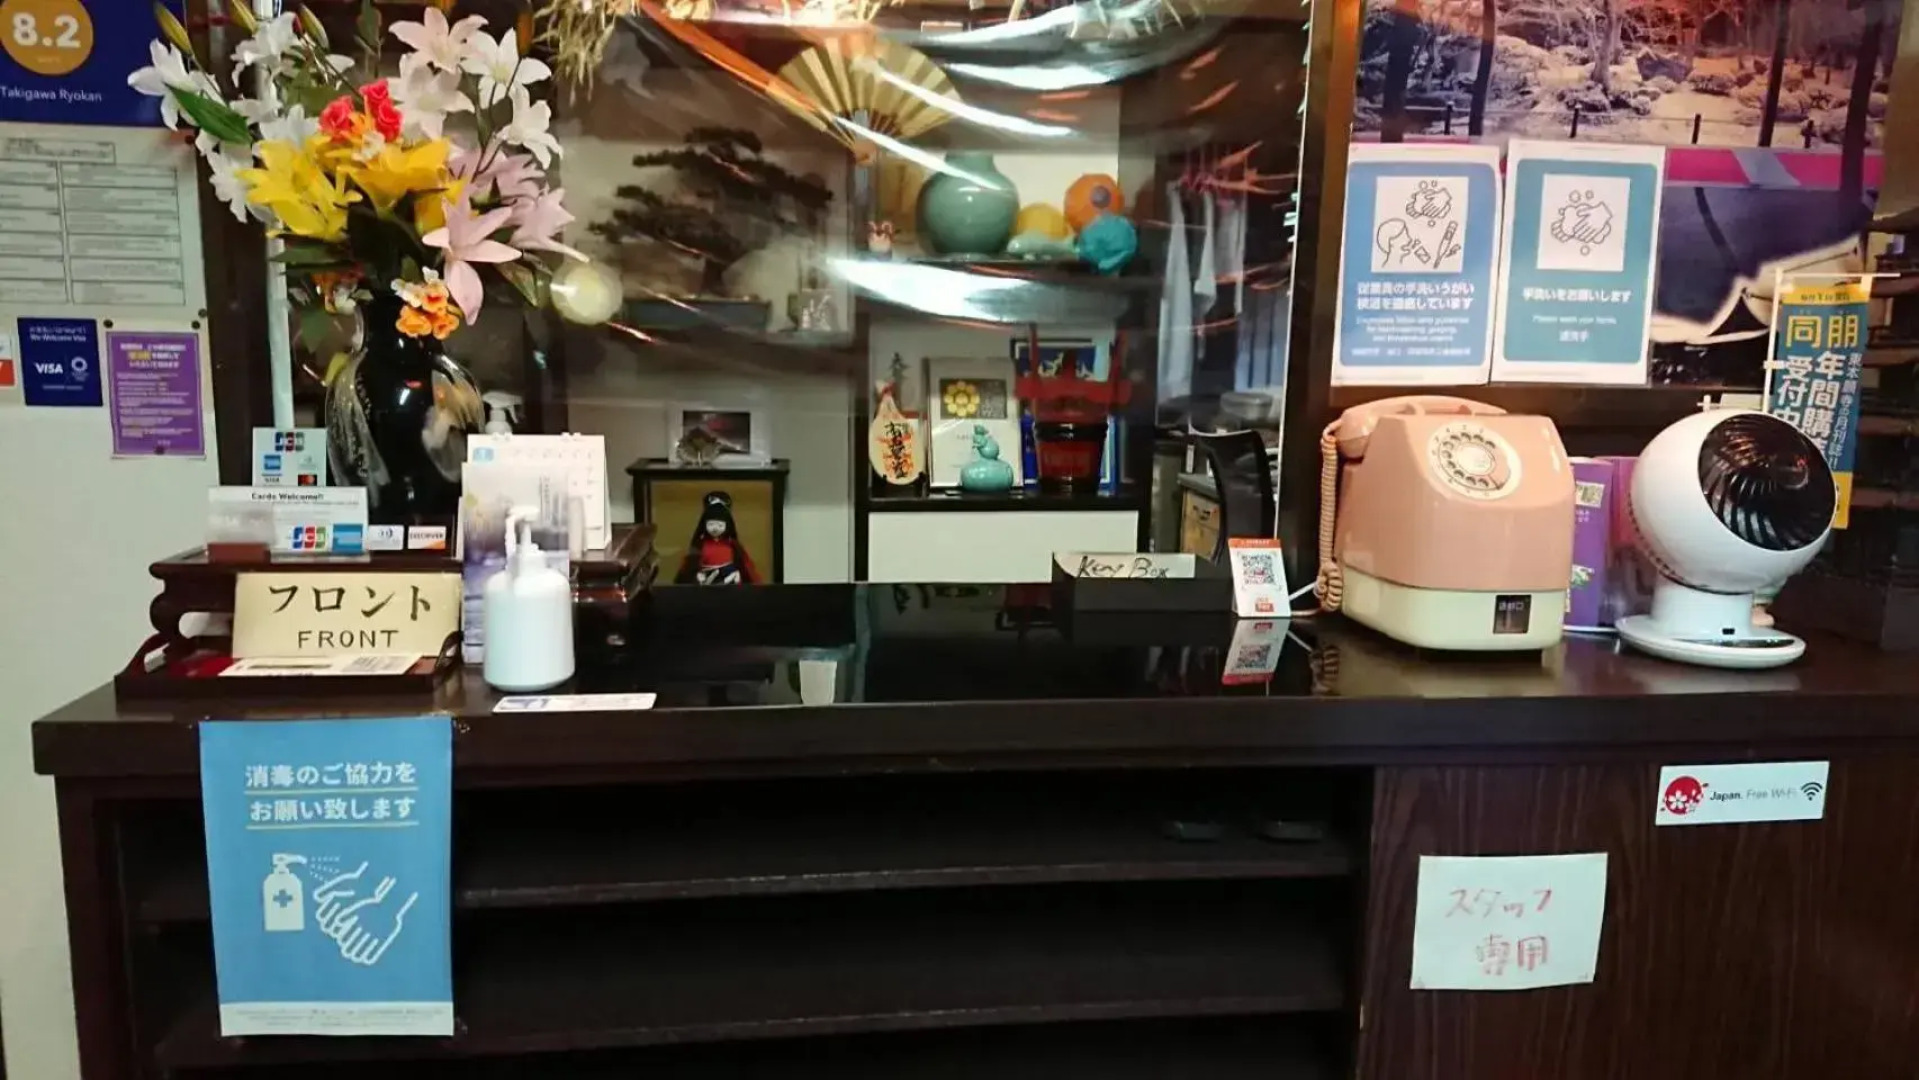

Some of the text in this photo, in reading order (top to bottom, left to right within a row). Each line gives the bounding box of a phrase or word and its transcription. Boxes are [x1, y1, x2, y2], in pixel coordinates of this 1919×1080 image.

[13, 12, 81, 47] 8.2
[0, 85, 102, 103] Takigawa Ryokan
[1785, 314, 1859, 349] 同朋
[33, 362, 64, 375] VISA
[275, 431, 306, 452] JCB
[251, 493, 277, 501] Cards
[292, 526, 327, 549] JCB
[1128, 557, 1170, 579] Box
[268, 584, 432, 622] フロント
[297, 630, 399, 649] FRONT
[245, 761, 417, 789] 消毒のご協力を
[1746, 789, 1768, 799] Free
[249, 796, 416, 823] お願い致します
[1445, 888, 1553, 918] スタッフ
